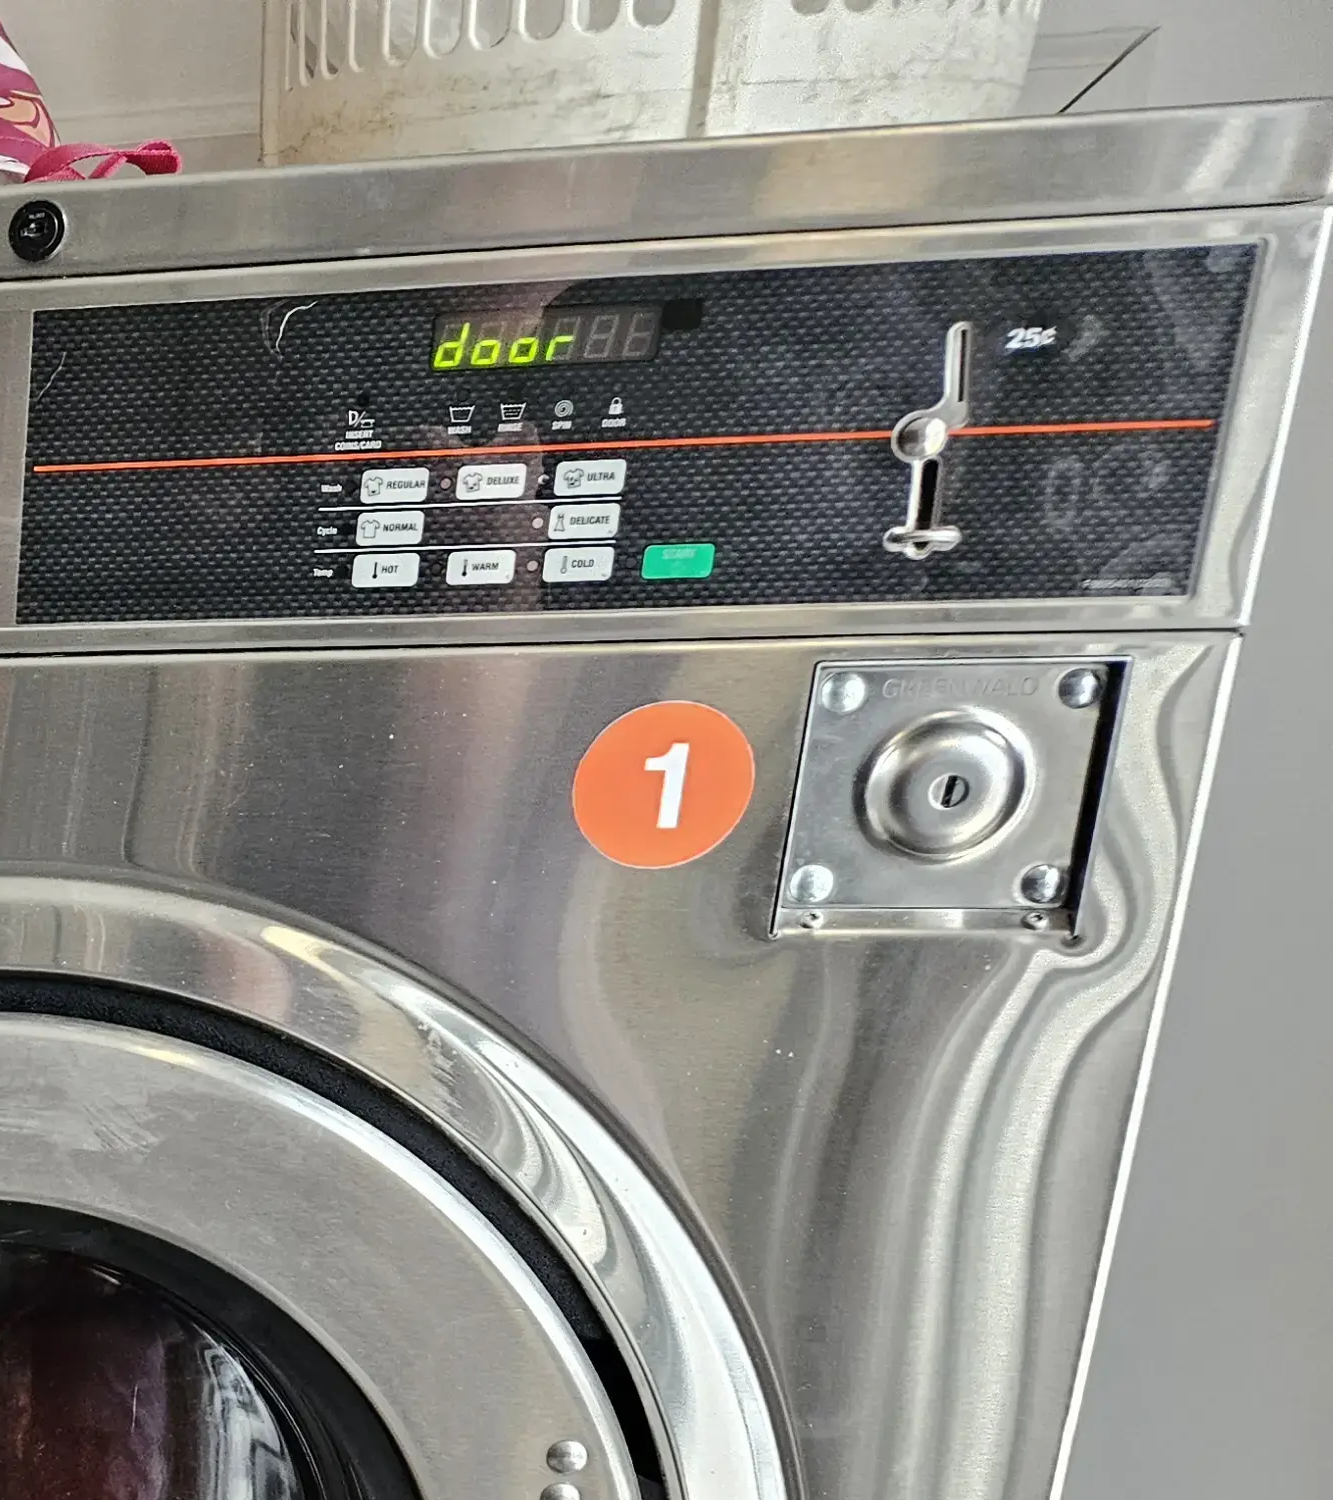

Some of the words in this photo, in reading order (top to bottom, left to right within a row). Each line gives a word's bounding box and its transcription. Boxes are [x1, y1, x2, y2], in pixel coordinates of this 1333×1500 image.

[1005, 326, 1057, 348] 25¢
[433, 322, 575, 368] door
[486, 475, 520, 486] DELUXE
[586, 471, 615, 481] ULTRA
[386, 479, 426, 490] REGULAR
[570, 515, 611, 525] DELICATE
[383, 522, 418, 531] NORMAL
[472, 563, 499, 571] WARM
[571, 560, 594, 568] COLD
[381, 565, 398, 574] HOT
[883, 676, 1040, 699] GREENWALD
[644, 743, 689, 828] 1
